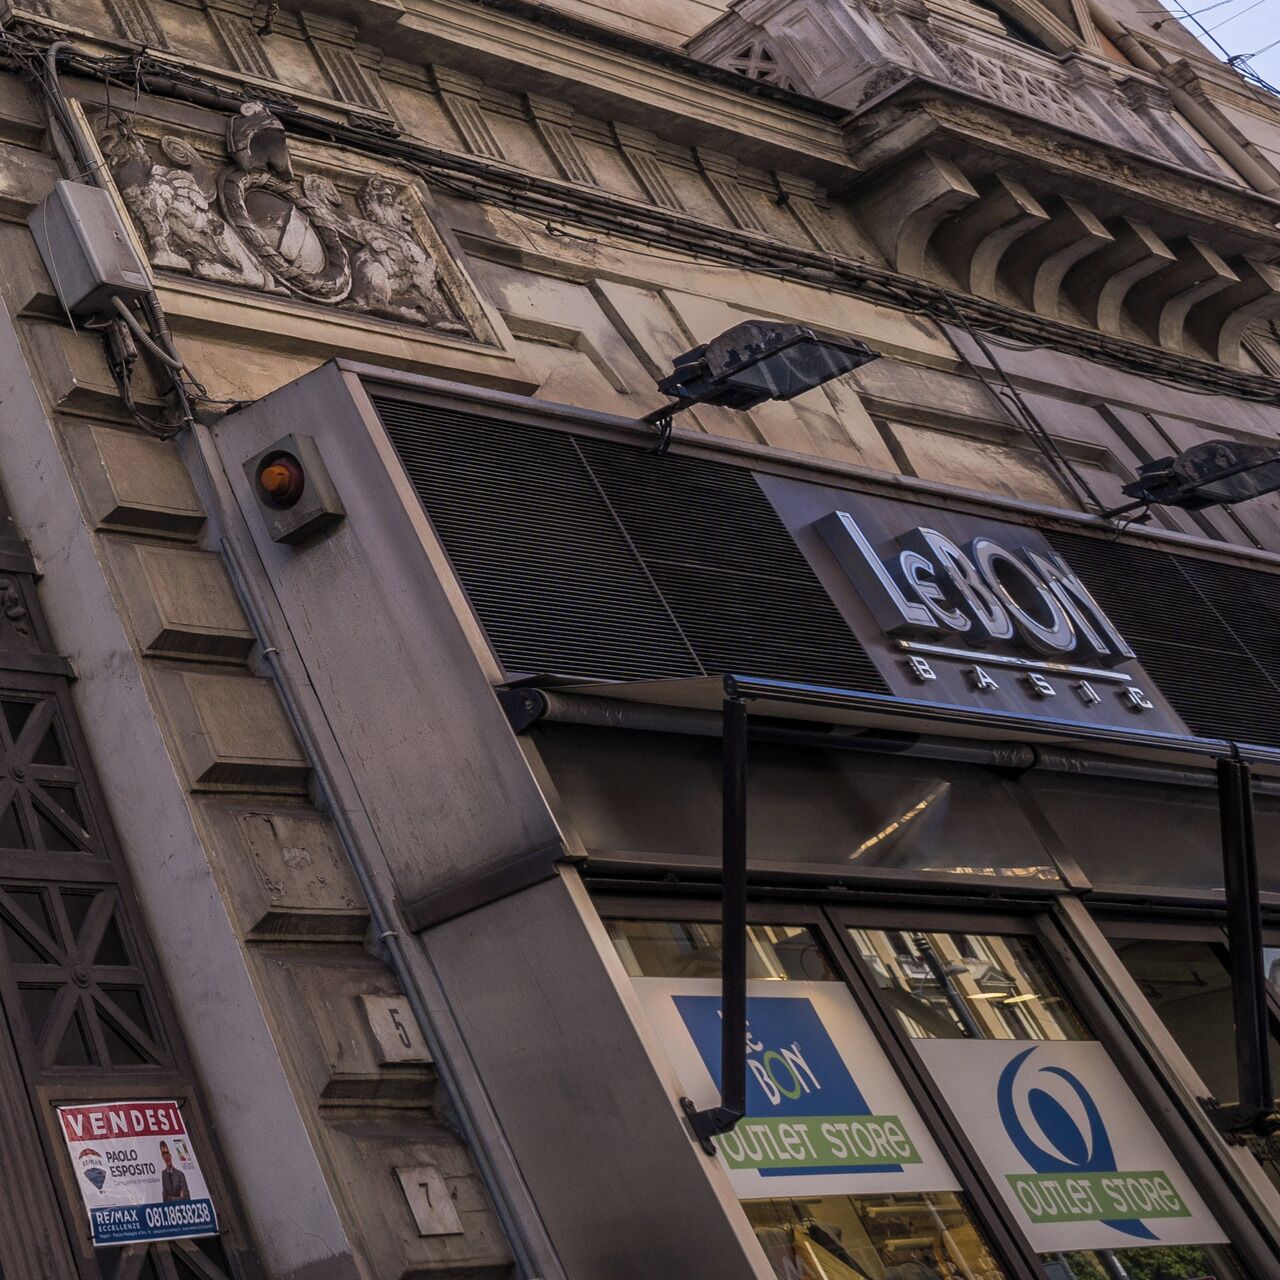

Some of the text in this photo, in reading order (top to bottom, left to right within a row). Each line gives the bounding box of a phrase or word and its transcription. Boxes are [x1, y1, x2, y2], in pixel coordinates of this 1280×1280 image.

[907, 654, 1154, 709] BASIC
[387, 1007, 412, 1049] 5
[746, 1043, 822, 1106] BON
[66, 1108, 180, 1137] VENDESI
[105, 1149, 138, 1163] PAOLO
[109, 1162, 156, 1178] ESPOSITO
[418, 1182, 433, 1209] 7
[95, 1210, 139, 1225] RE/MAX
[98, 1222, 141, 1233] ECCELLENZE
[145, 1203, 211, 1228] 081.18638238
